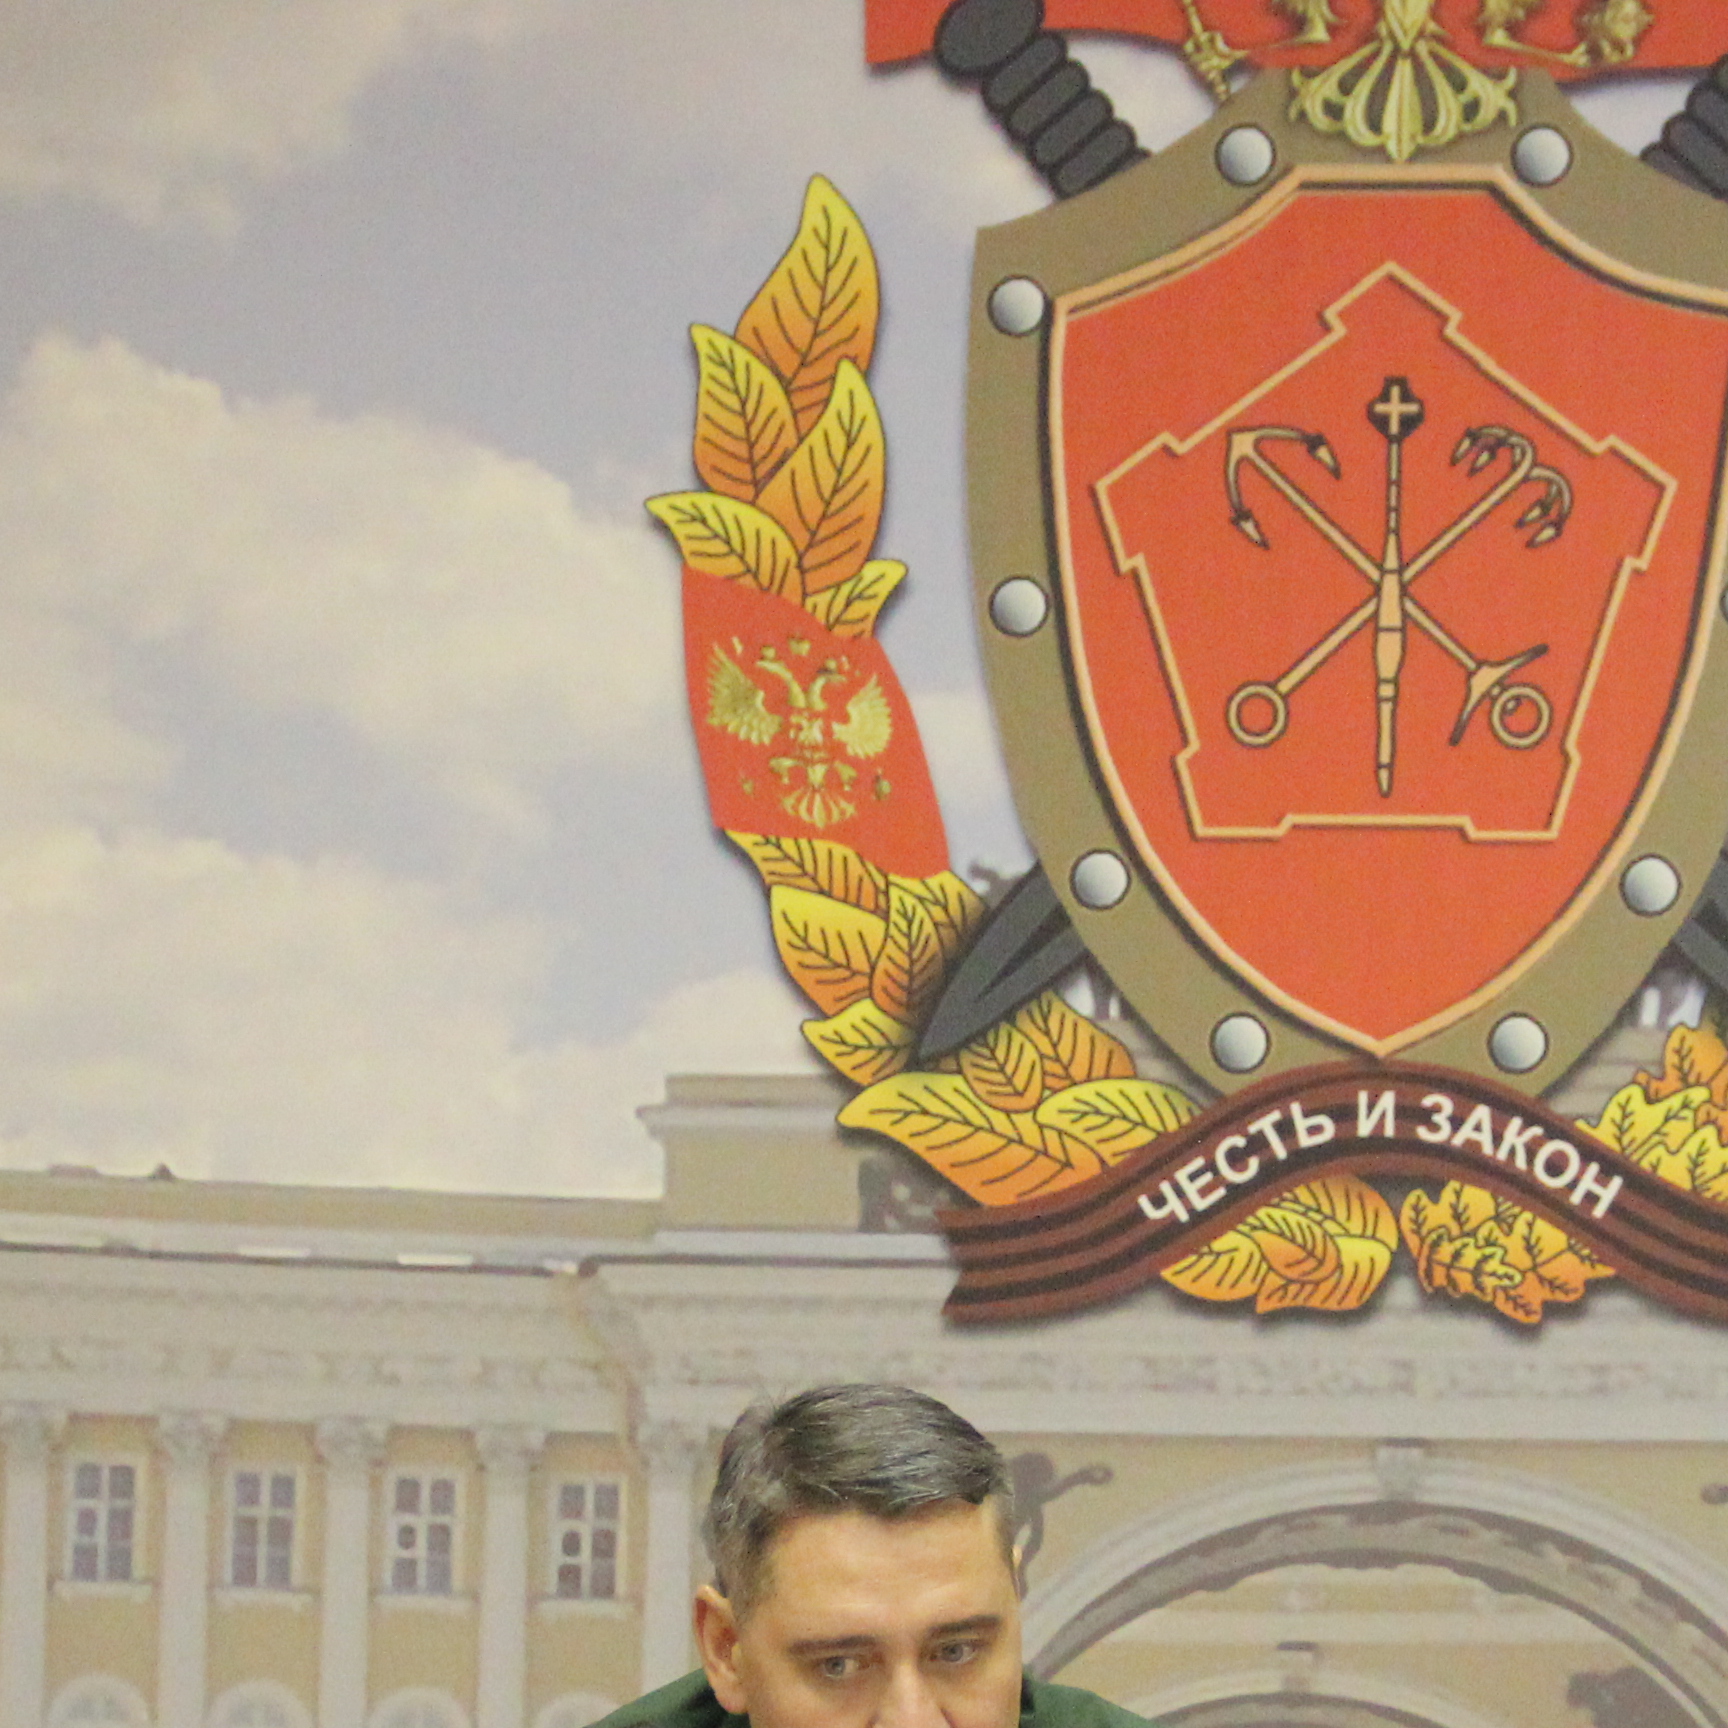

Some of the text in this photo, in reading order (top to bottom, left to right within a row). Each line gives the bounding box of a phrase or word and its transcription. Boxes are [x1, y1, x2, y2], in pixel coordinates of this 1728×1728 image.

[1138, 1090, 1623, 1223] ЧЕСТЬ И ЗАКОН
